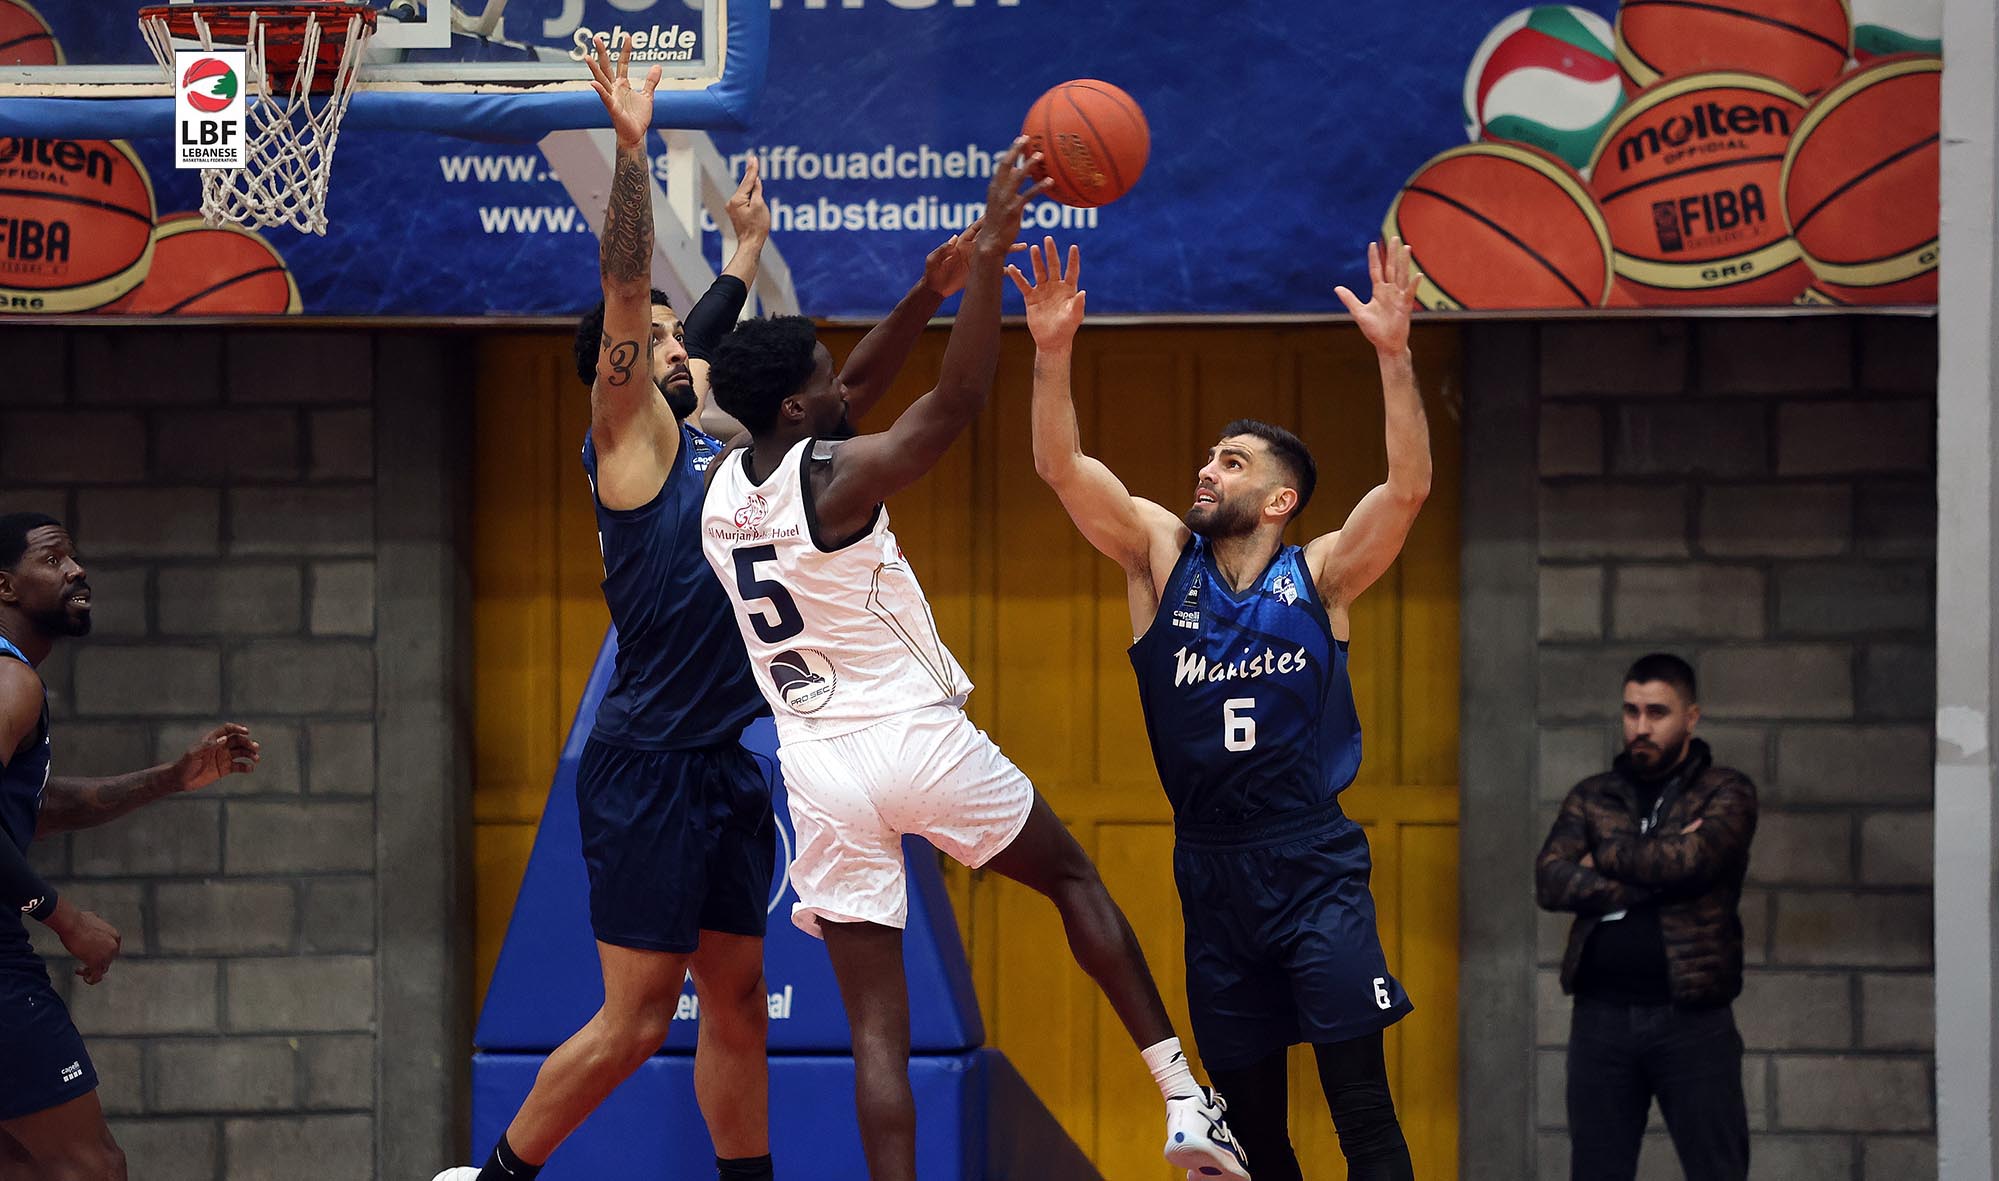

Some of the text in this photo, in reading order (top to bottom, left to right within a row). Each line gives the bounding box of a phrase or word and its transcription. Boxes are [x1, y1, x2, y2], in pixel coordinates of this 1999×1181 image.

[569, 25, 697, 61] Schelde
[590, 48, 693, 61] itenational
[1617, 102, 1790, 171] molten
[1679, 183, 1766, 237] FIBA
[715, 529, 752, 545] Murjan
[772, 524, 800, 539] Hotel
[732, 544, 805, 644] 5
[1173, 646, 1307, 688] Maristes
[1223, 697, 1256, 752] 6
[1373, 977, 1392, 1010] 6
